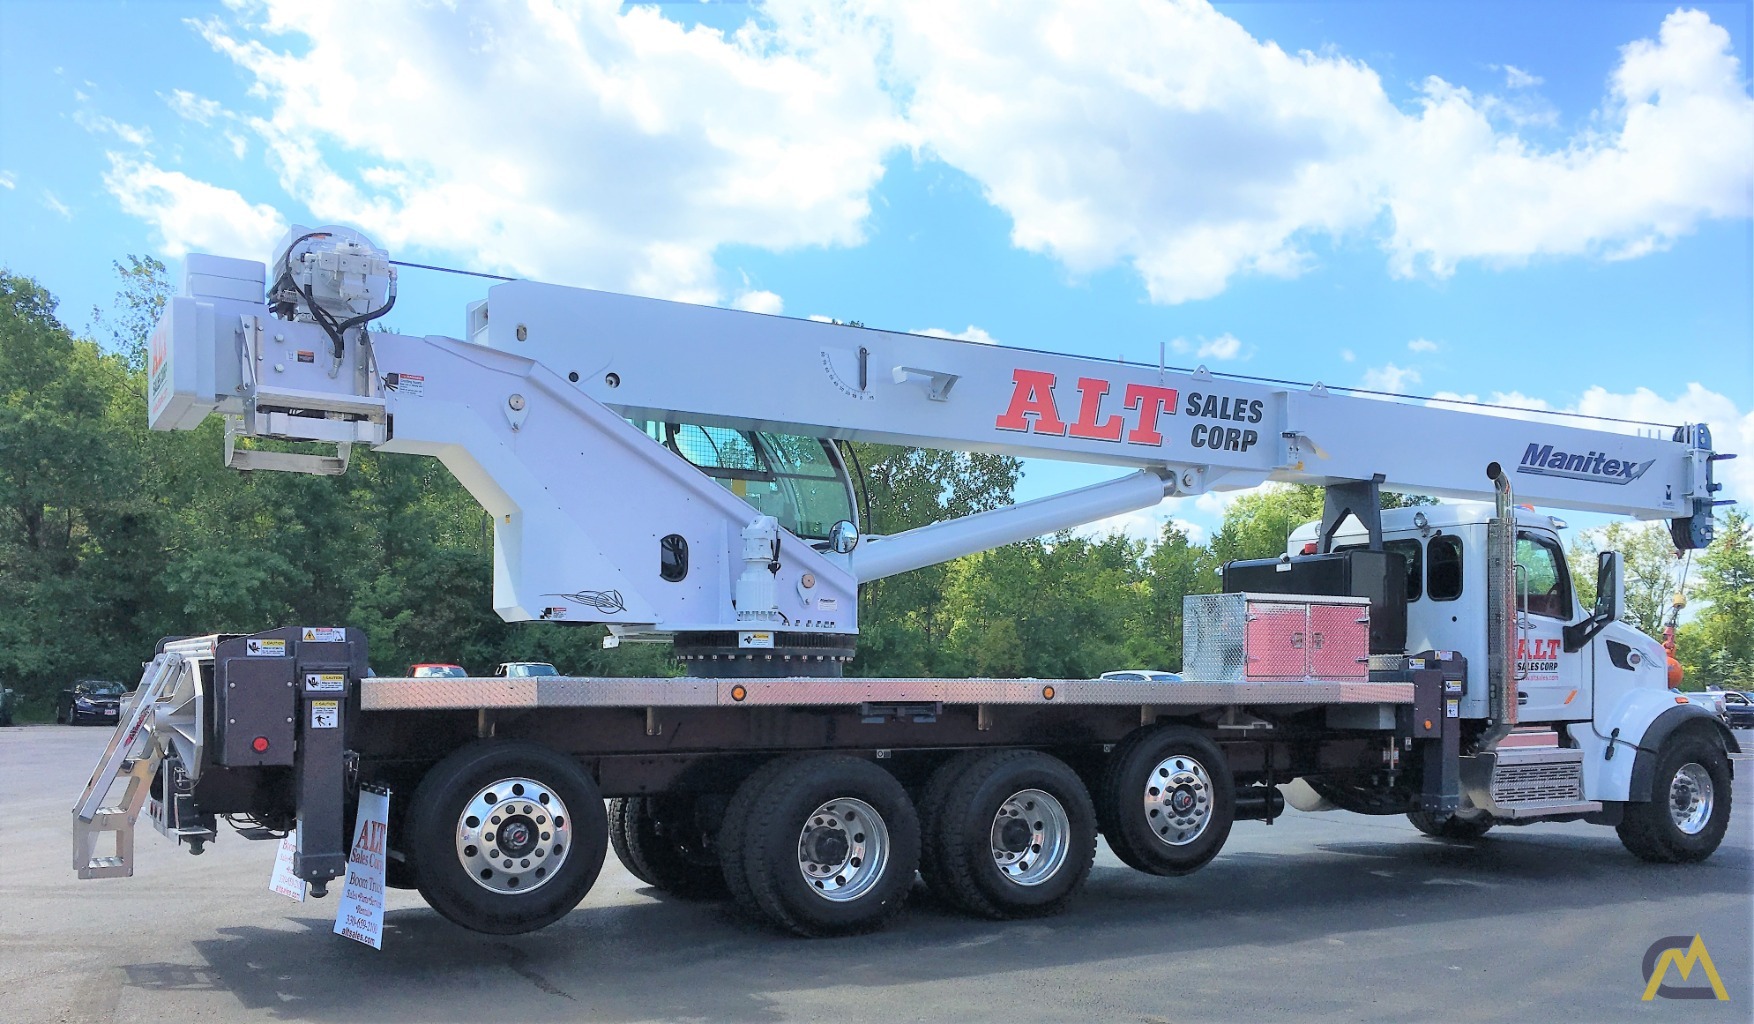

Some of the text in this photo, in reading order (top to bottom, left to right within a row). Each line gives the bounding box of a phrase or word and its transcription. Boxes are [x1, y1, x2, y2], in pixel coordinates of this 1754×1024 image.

[995, 368, 1179, 447] ALT
[1185, 391, 1264, 424] SALES
[1190, 423, 1259, 453] CORP
[1520, 442, 1638, 478] Manitex
[1516, 638, 1561, 660] ALT
[1517, 662, 1559, 671] SALES CORP
[355, 819, 386, 855] ALT
[350, 848, 369, 866] Sales
[349, 871, 368, 890] Boom
[342, 927, 375, 945] altsales.com
